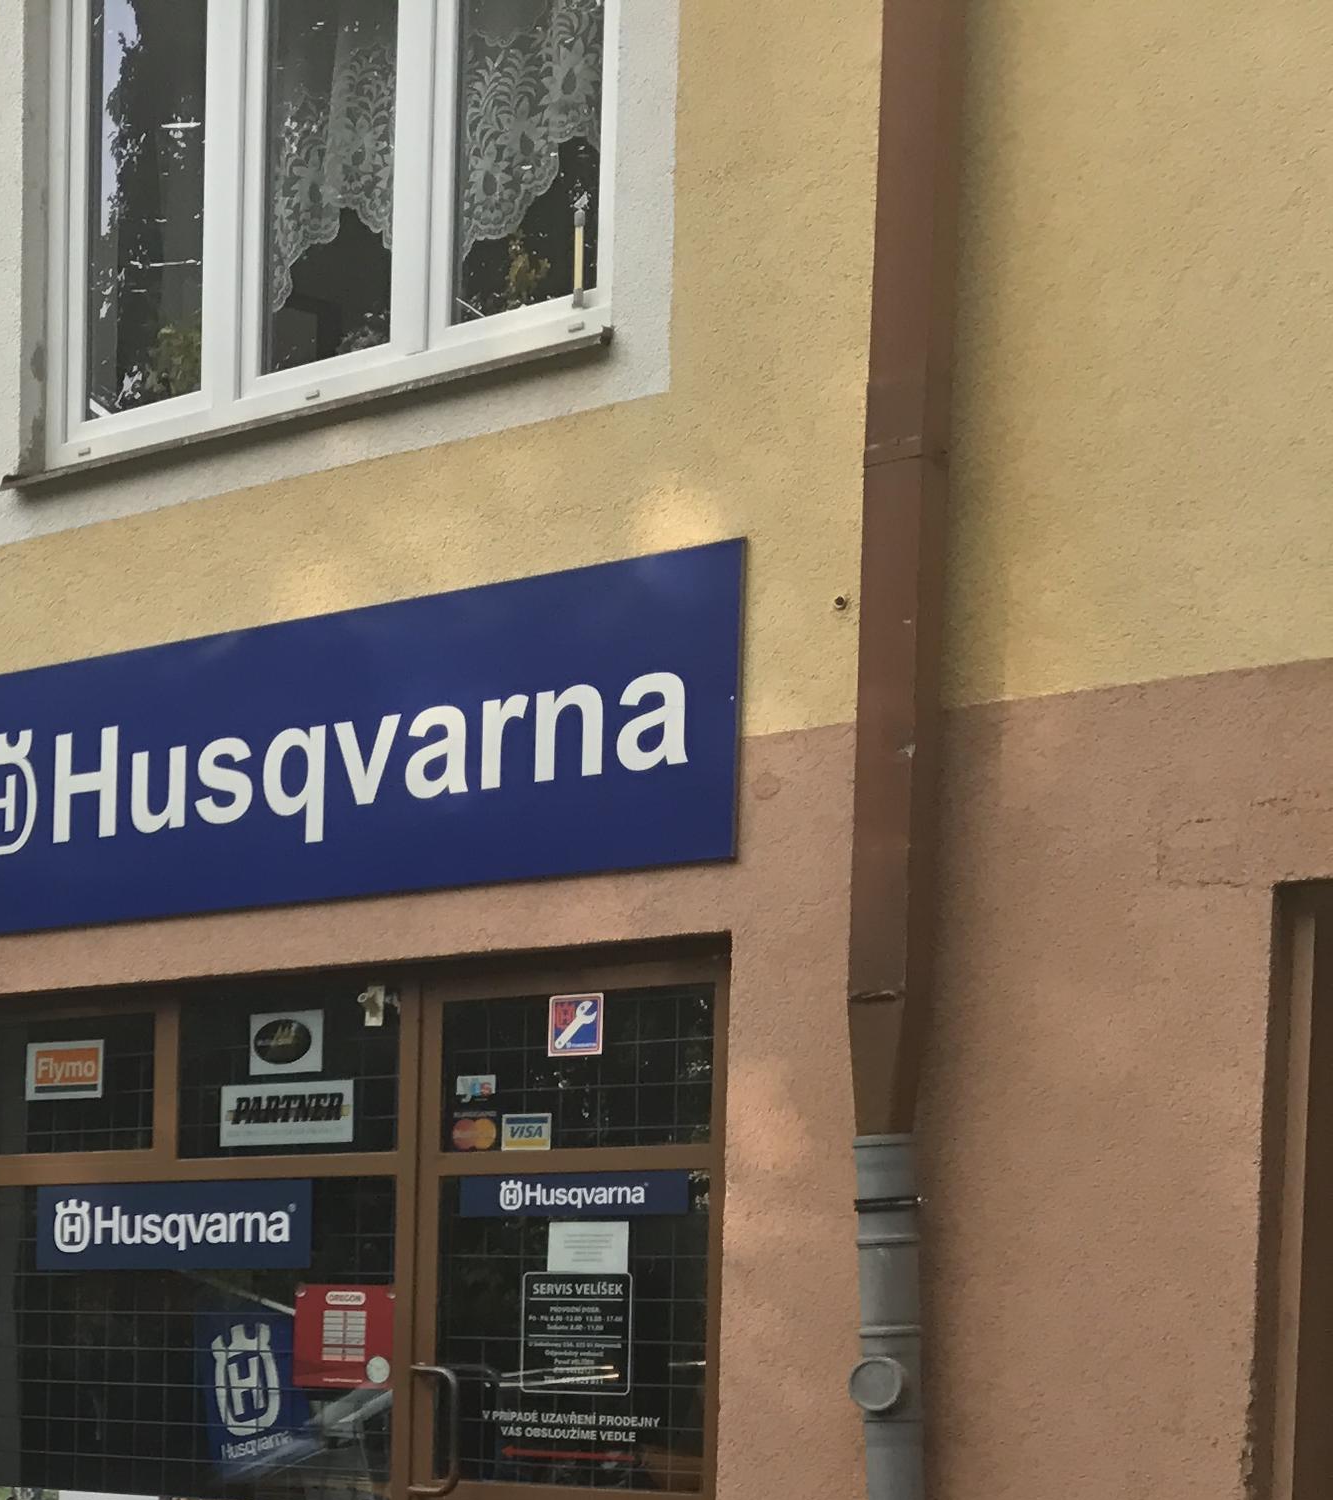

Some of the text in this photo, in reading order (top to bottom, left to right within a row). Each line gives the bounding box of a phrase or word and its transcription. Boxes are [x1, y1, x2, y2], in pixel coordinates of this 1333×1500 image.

[52, 670, 690, 845] Husqvarna
[36, 1057, 96, 1083] Flymo
[509, 1125, 543, 1139] VISA
[524, 1183, 646, 1209] Husqvarna
[93, 1205, 290, 1251] Husqvarna
[533, 1281, 624, 1296] SERVIS VELÍŠEK
[482, 1410, 491, 1420] V
[540, 1410, 596, 1425] UZAVŘENÍ
[598, 1414, 661, 1428] PRODEJNY
[221, 1430, 294, 1460] Husqvarna
[500, 1424, 636, 1443] VÁS OBSLOUŽÍME VEDLE
